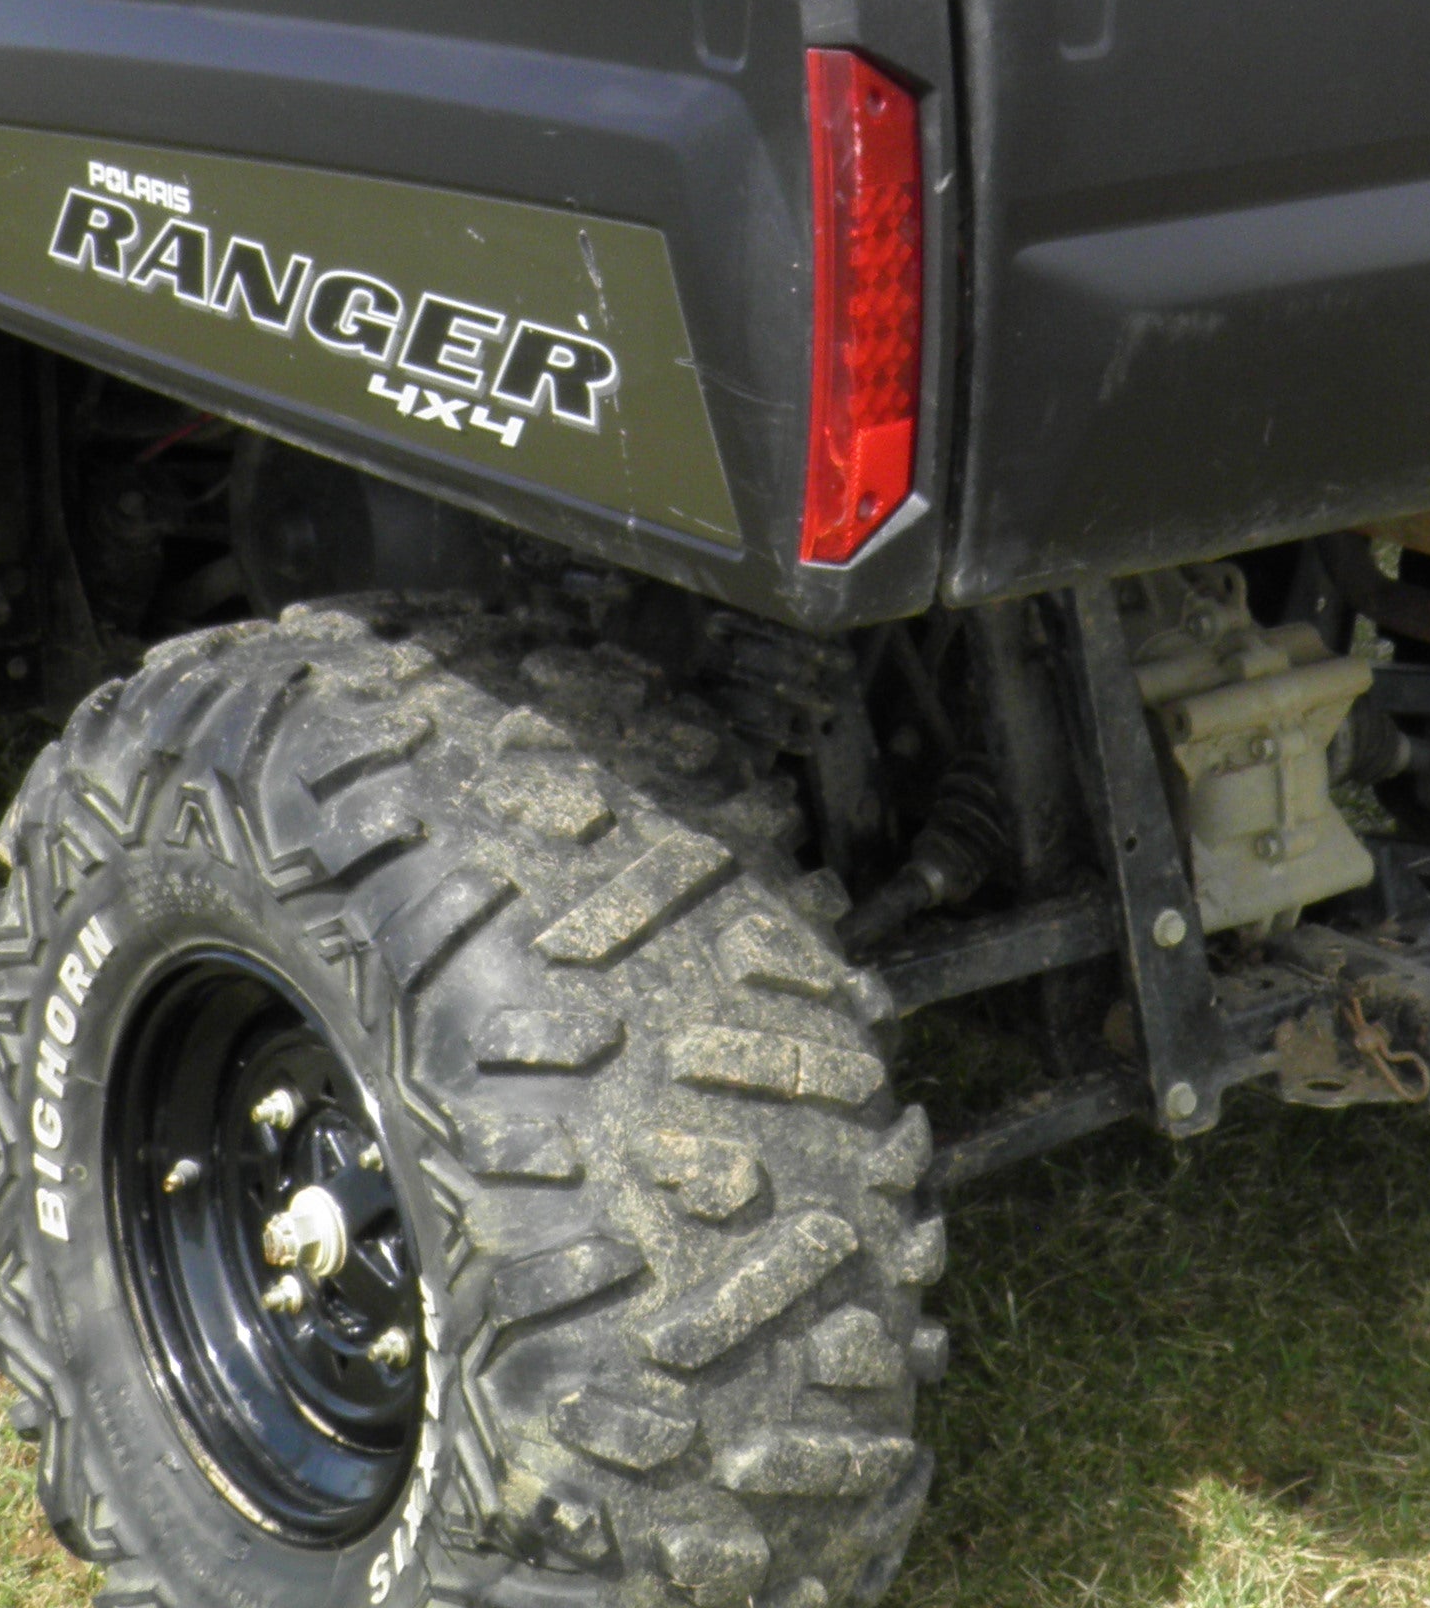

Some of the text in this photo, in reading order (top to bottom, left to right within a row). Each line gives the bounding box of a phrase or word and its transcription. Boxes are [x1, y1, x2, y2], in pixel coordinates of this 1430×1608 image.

[87, 160, 191, 213] POLARIS
[47, 187, 621, 434] RANGER
[32, 913, 115, 1242] BIGHORN
